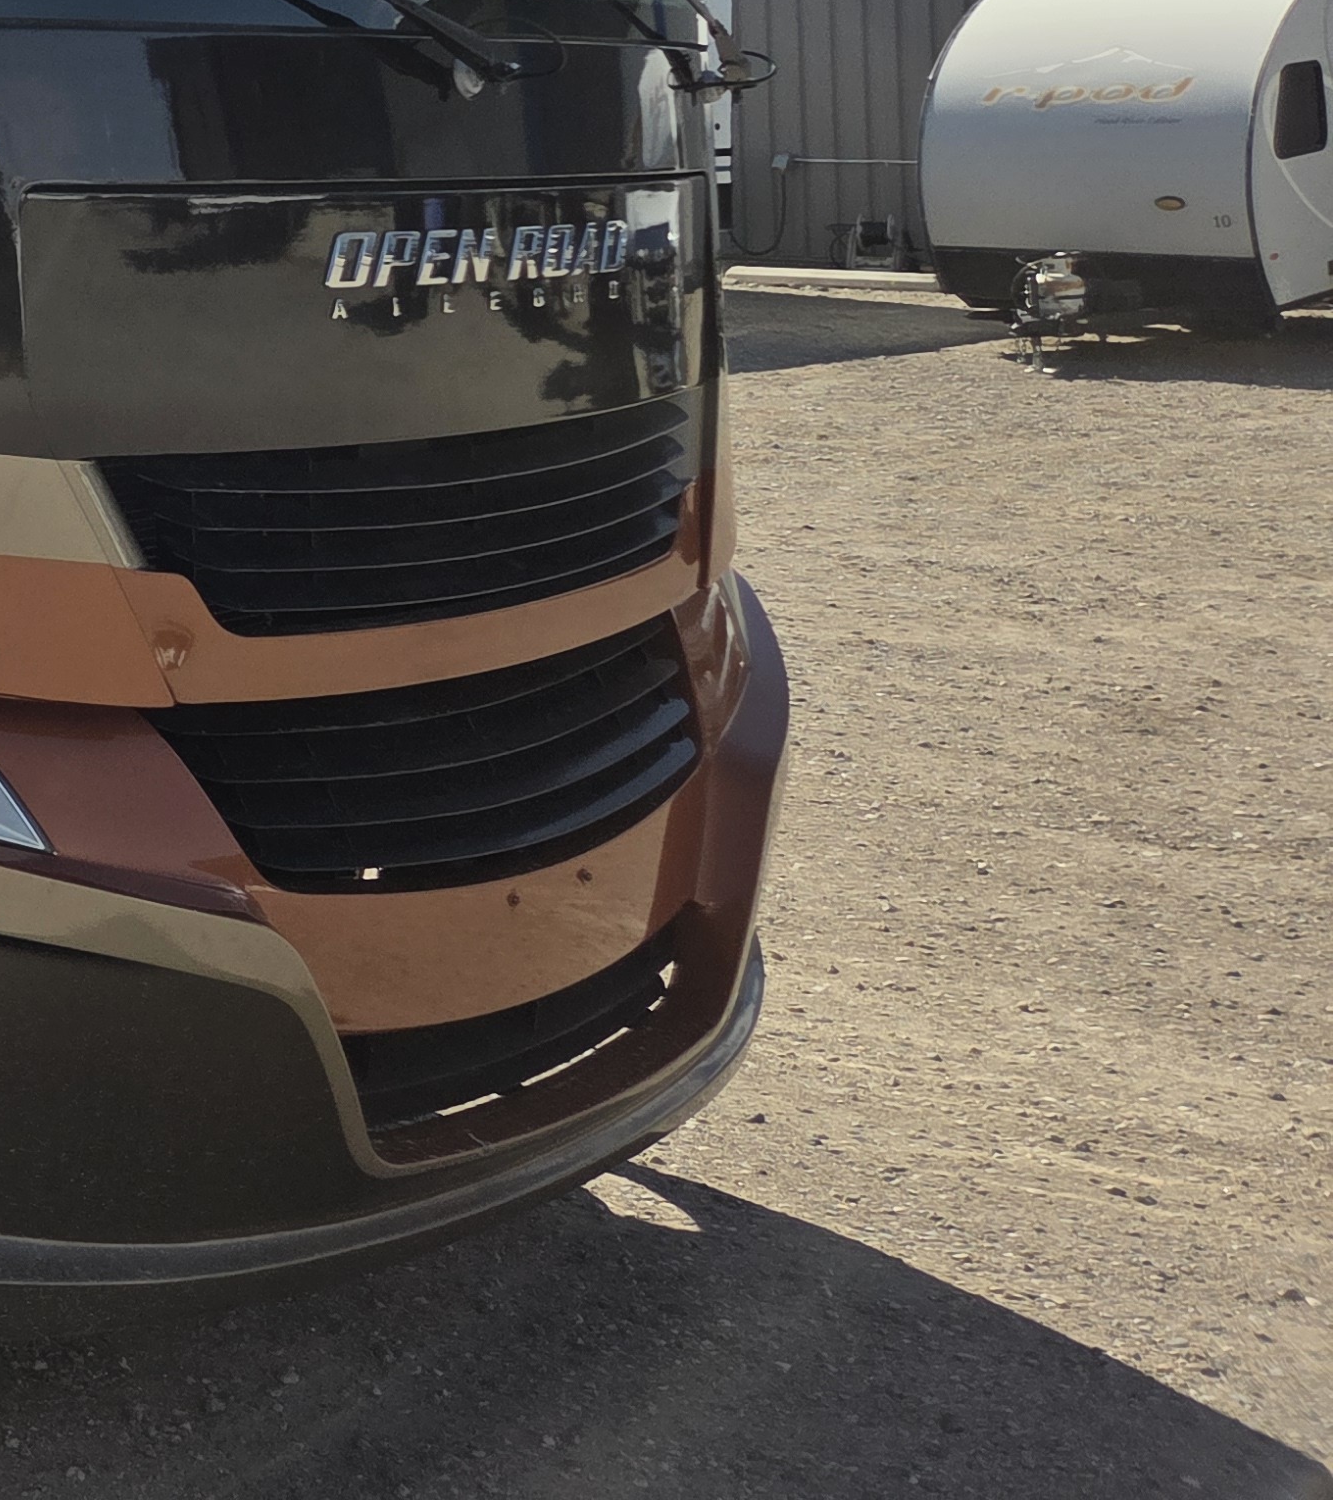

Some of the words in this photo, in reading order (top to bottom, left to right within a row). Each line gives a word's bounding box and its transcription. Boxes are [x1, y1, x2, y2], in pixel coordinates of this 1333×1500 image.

[1213, 214, 1232, 228] 10
[325, 228, 498, 288] OPEN
[507, 219, 628, 281] ROAD
